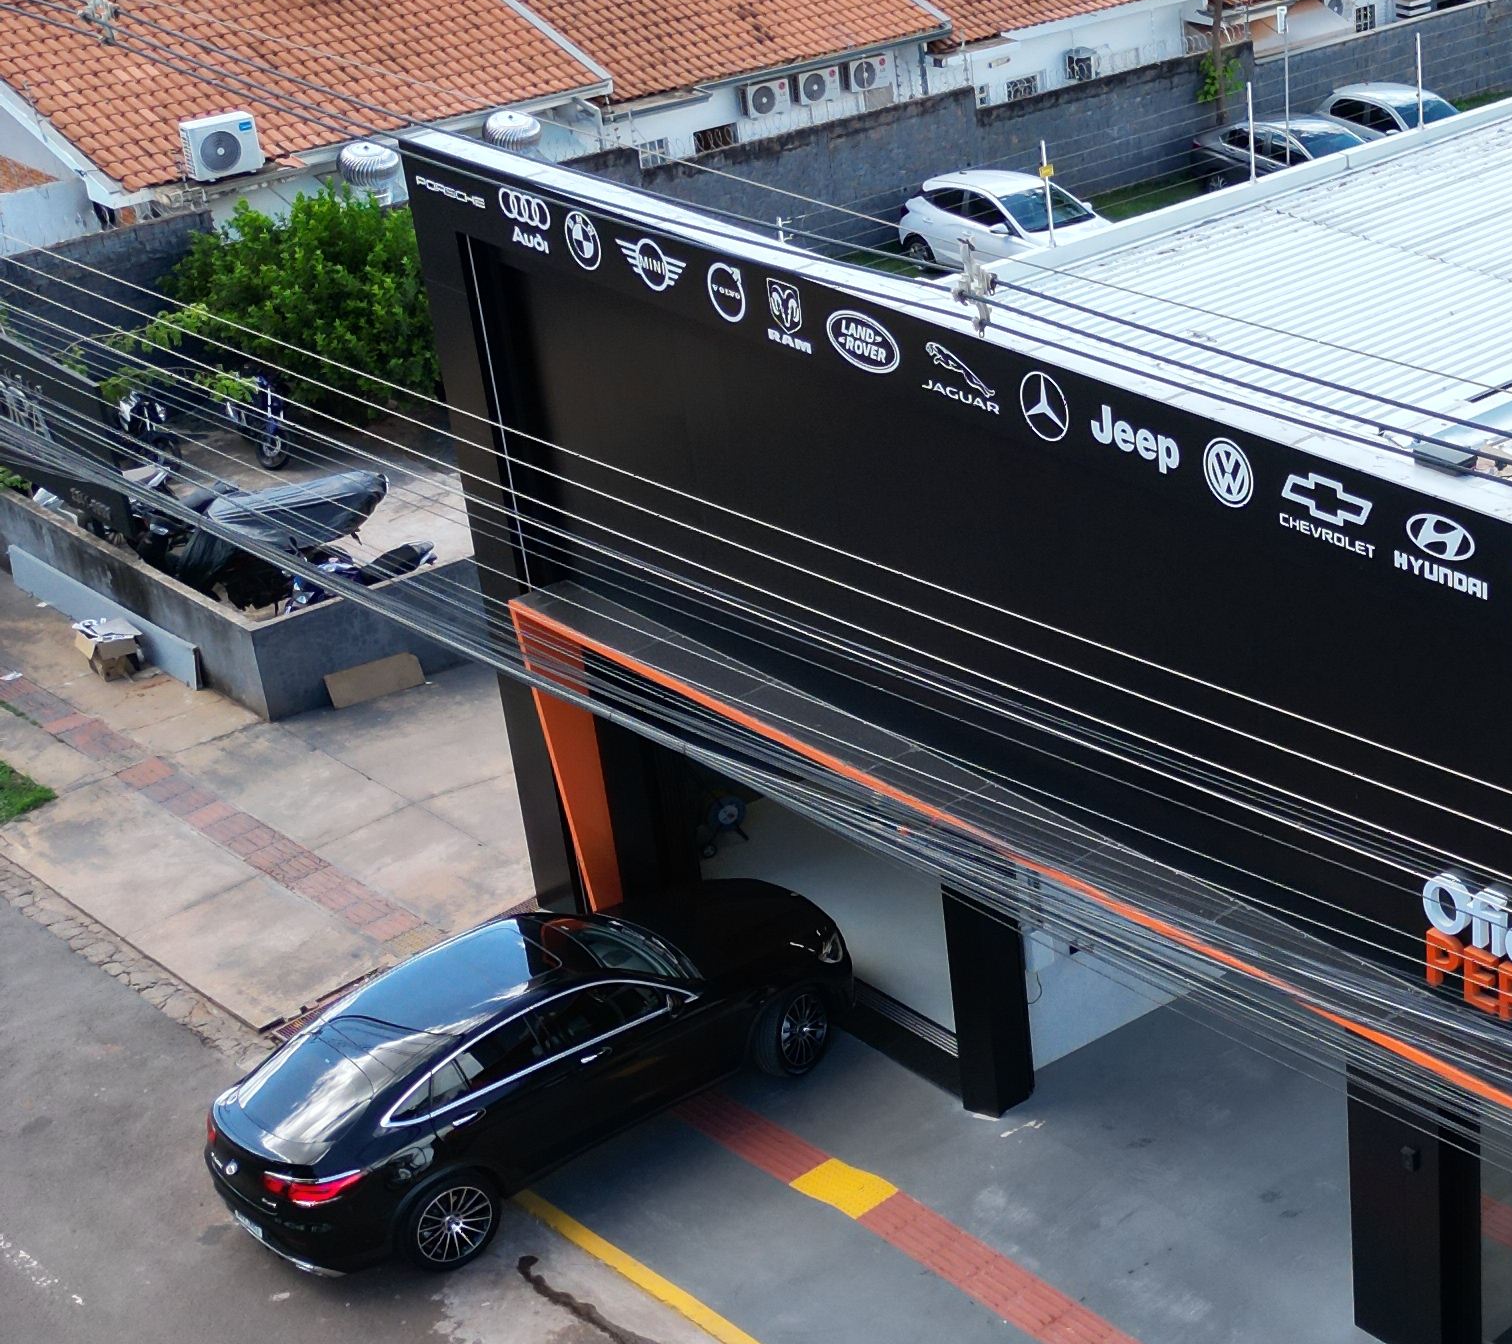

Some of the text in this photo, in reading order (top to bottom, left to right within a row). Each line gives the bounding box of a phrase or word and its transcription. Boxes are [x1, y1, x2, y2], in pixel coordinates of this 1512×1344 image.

[415, 175, 486, 209] PORSCHE
[512, 224, 550, 255] Audi
[637, 255, 666, 276] MINI
[711, 283, 742, 300] VOLVO
[767, 328, 812, 355] RAM
[840, 318, 876, 344] LAND
[844, 335, 887, 364] ROVER
[921, 379, 1000, 415] JAGUAR
[1090, 404, 1181, 475] Jeep
[1279, 512, 1376, 559] CHEVROLET
[1393, 549, 1489, 601] HYUNDAI
